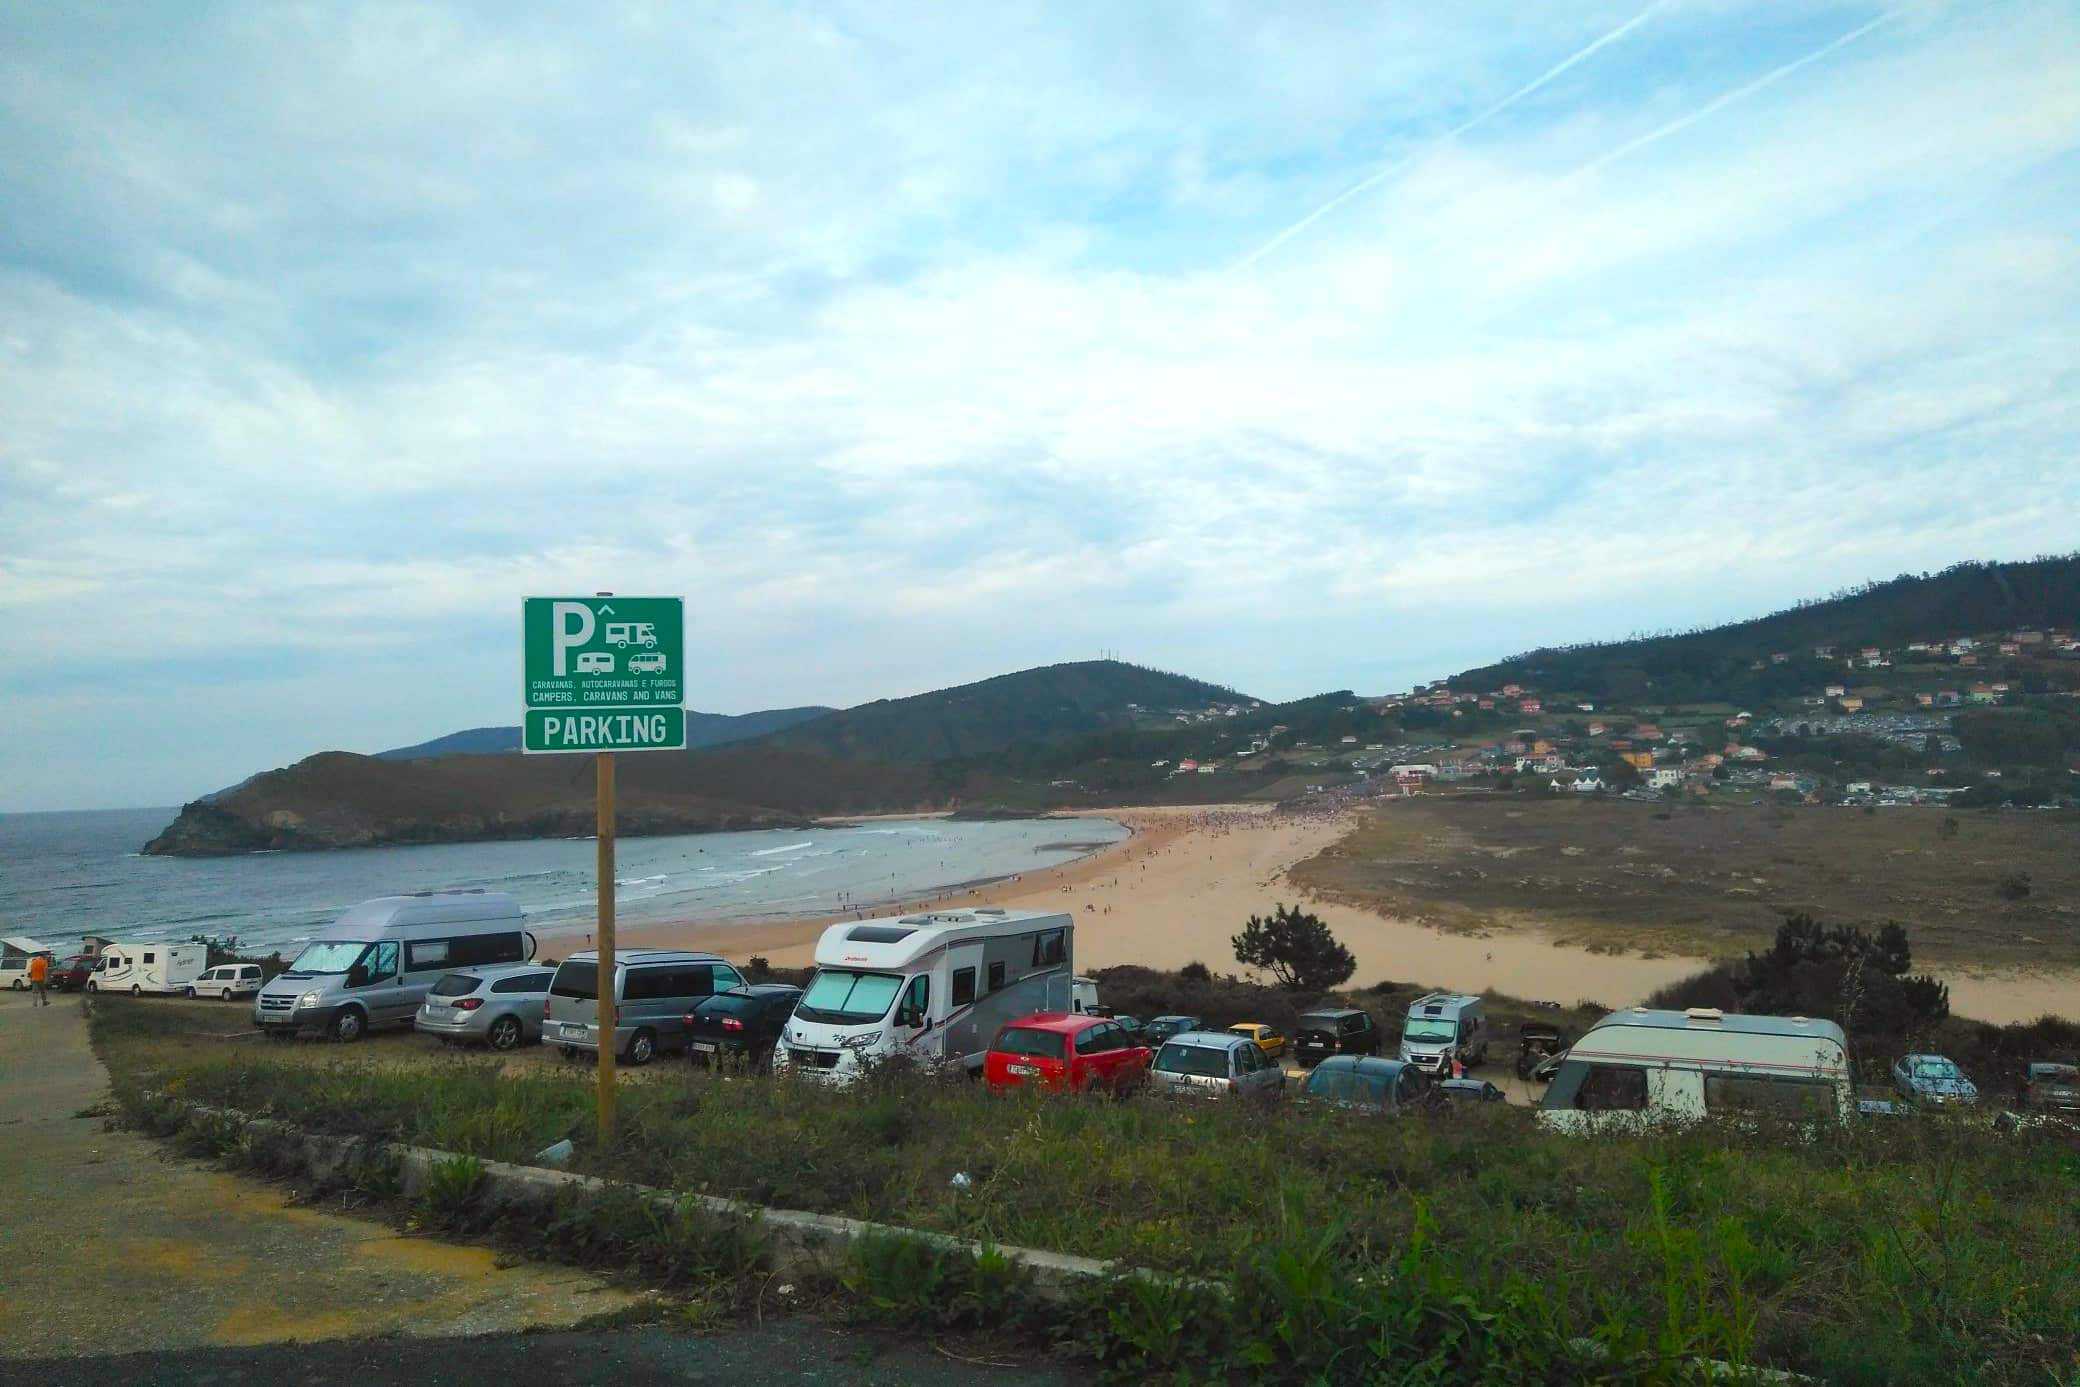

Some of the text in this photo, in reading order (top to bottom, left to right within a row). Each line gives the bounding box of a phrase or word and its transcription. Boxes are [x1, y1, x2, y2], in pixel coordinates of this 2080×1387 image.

[552, 601, 596, 676] P
[581, 679, 639, 689] AUTOCARAVANAS
[583, 690, 628, 701] CARAVANS
[633, 690, 650, 701] AND
[654, 690, 677, 699] VANS
[543, 714, 667, 746] PARKING
